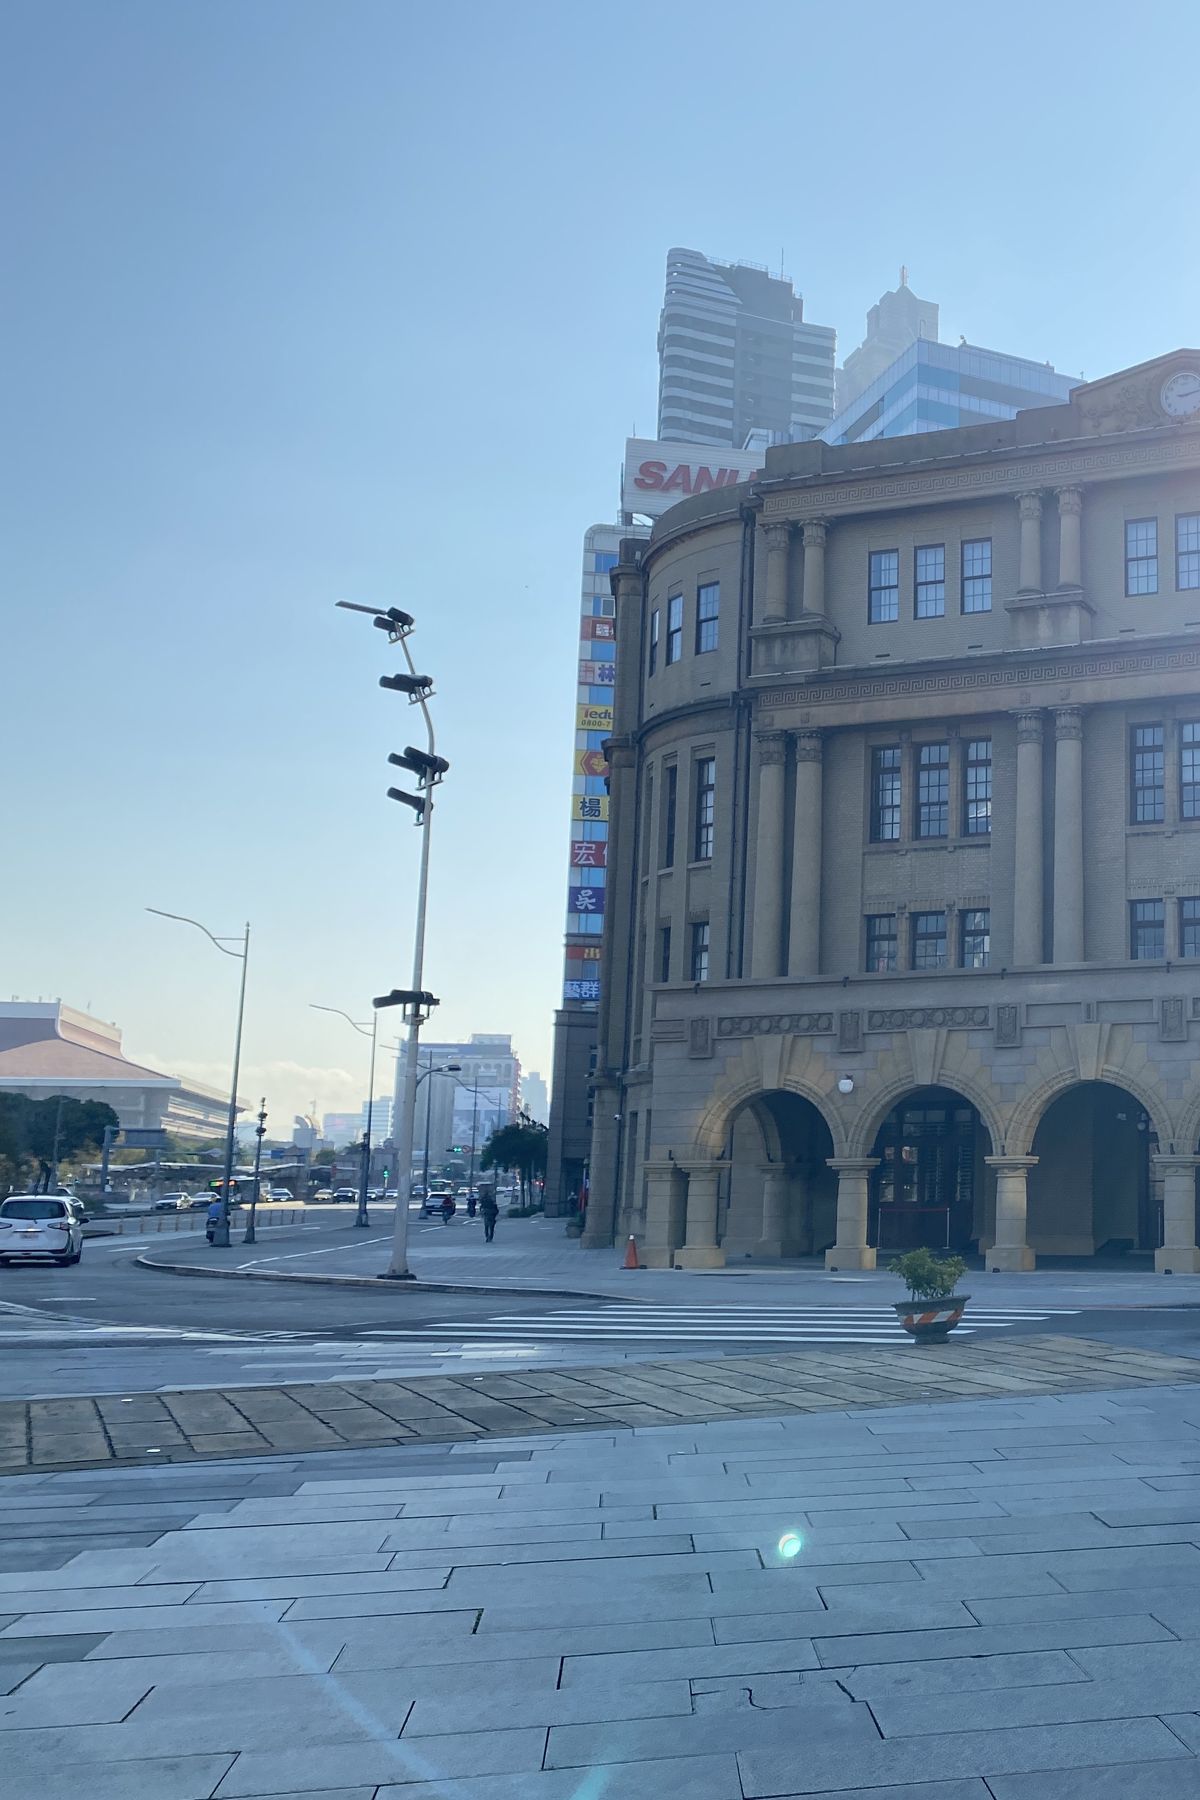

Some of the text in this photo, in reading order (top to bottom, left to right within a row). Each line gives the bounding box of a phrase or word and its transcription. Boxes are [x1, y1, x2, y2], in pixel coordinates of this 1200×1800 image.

[634, 460, 757, 496] SAN
[580, 797, 609, 817] 楊
[573, 842, 607, 866] 宏
[575, 889, 606, 910] 吳
